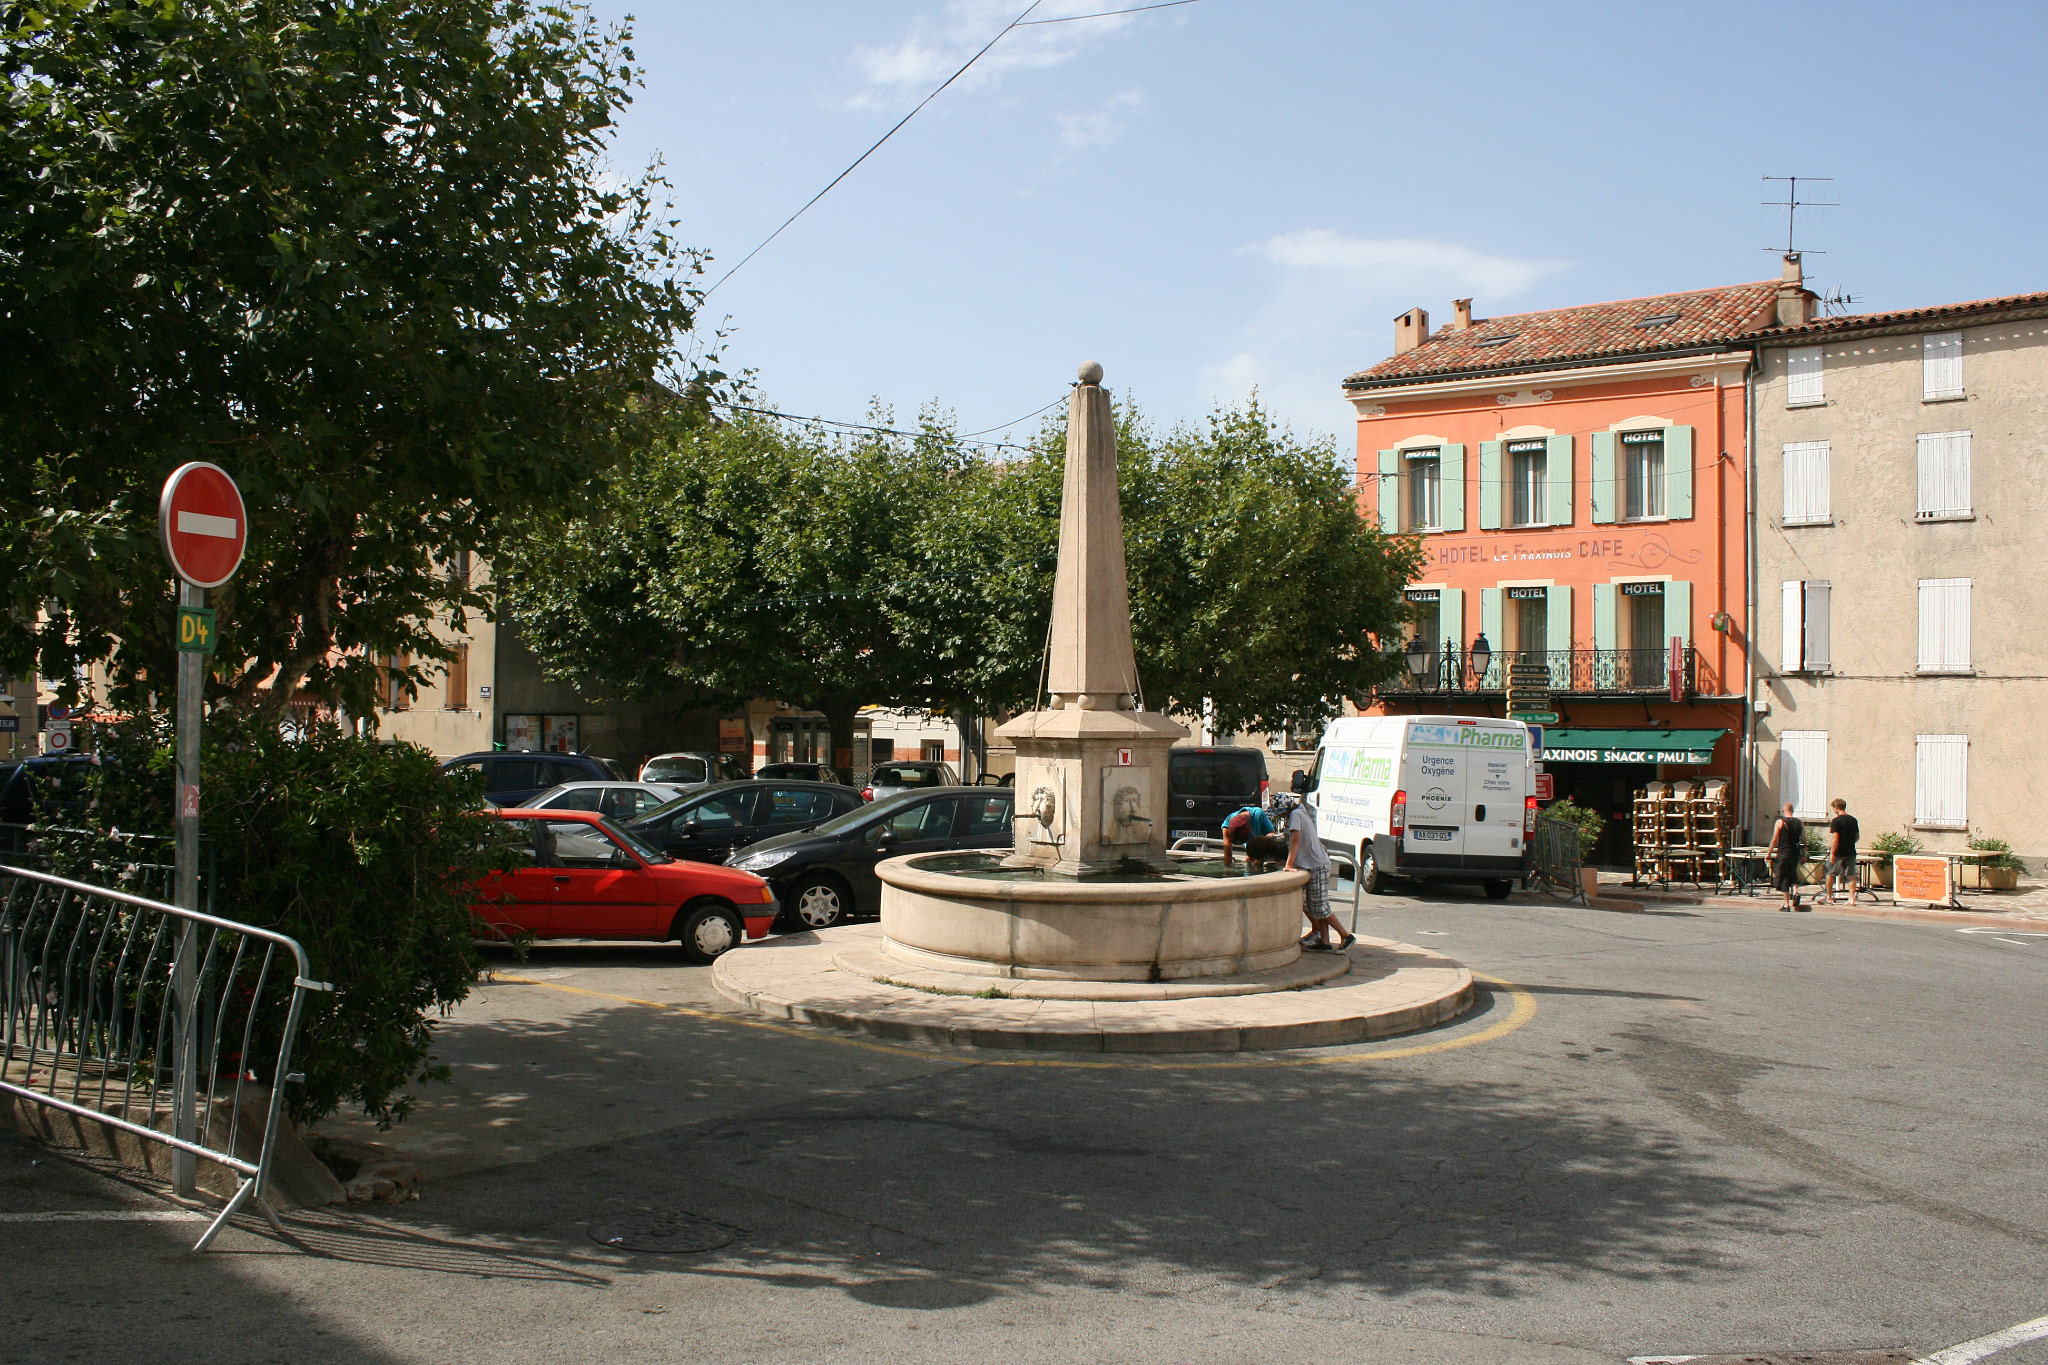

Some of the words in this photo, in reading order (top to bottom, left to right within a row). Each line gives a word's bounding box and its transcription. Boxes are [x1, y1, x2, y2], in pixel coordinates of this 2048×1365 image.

[1439, 546, 1488, 564] HOTEL
[1578, 540, 1623, 558] CAFE
[1407, 590, 1440, 600] HOTEL
[1510, 588, 1545, 598] HOTEL
[1624, 583, 1662, 595] HOTEL
[181, 615, 208, 645] D4
[1460, 728, 1524, 747] Pharma
[1422, 755, 1455, 766] Urgence
[1542, 749, 1598, 761] AXINOIS
[1604, 751, 1645, 762] SNACK
[1657, 752, 1685, 763] PMU
[1352, 750, 1392, 780] Pharma
[1421, 765, 1455, 777] Oxygène
